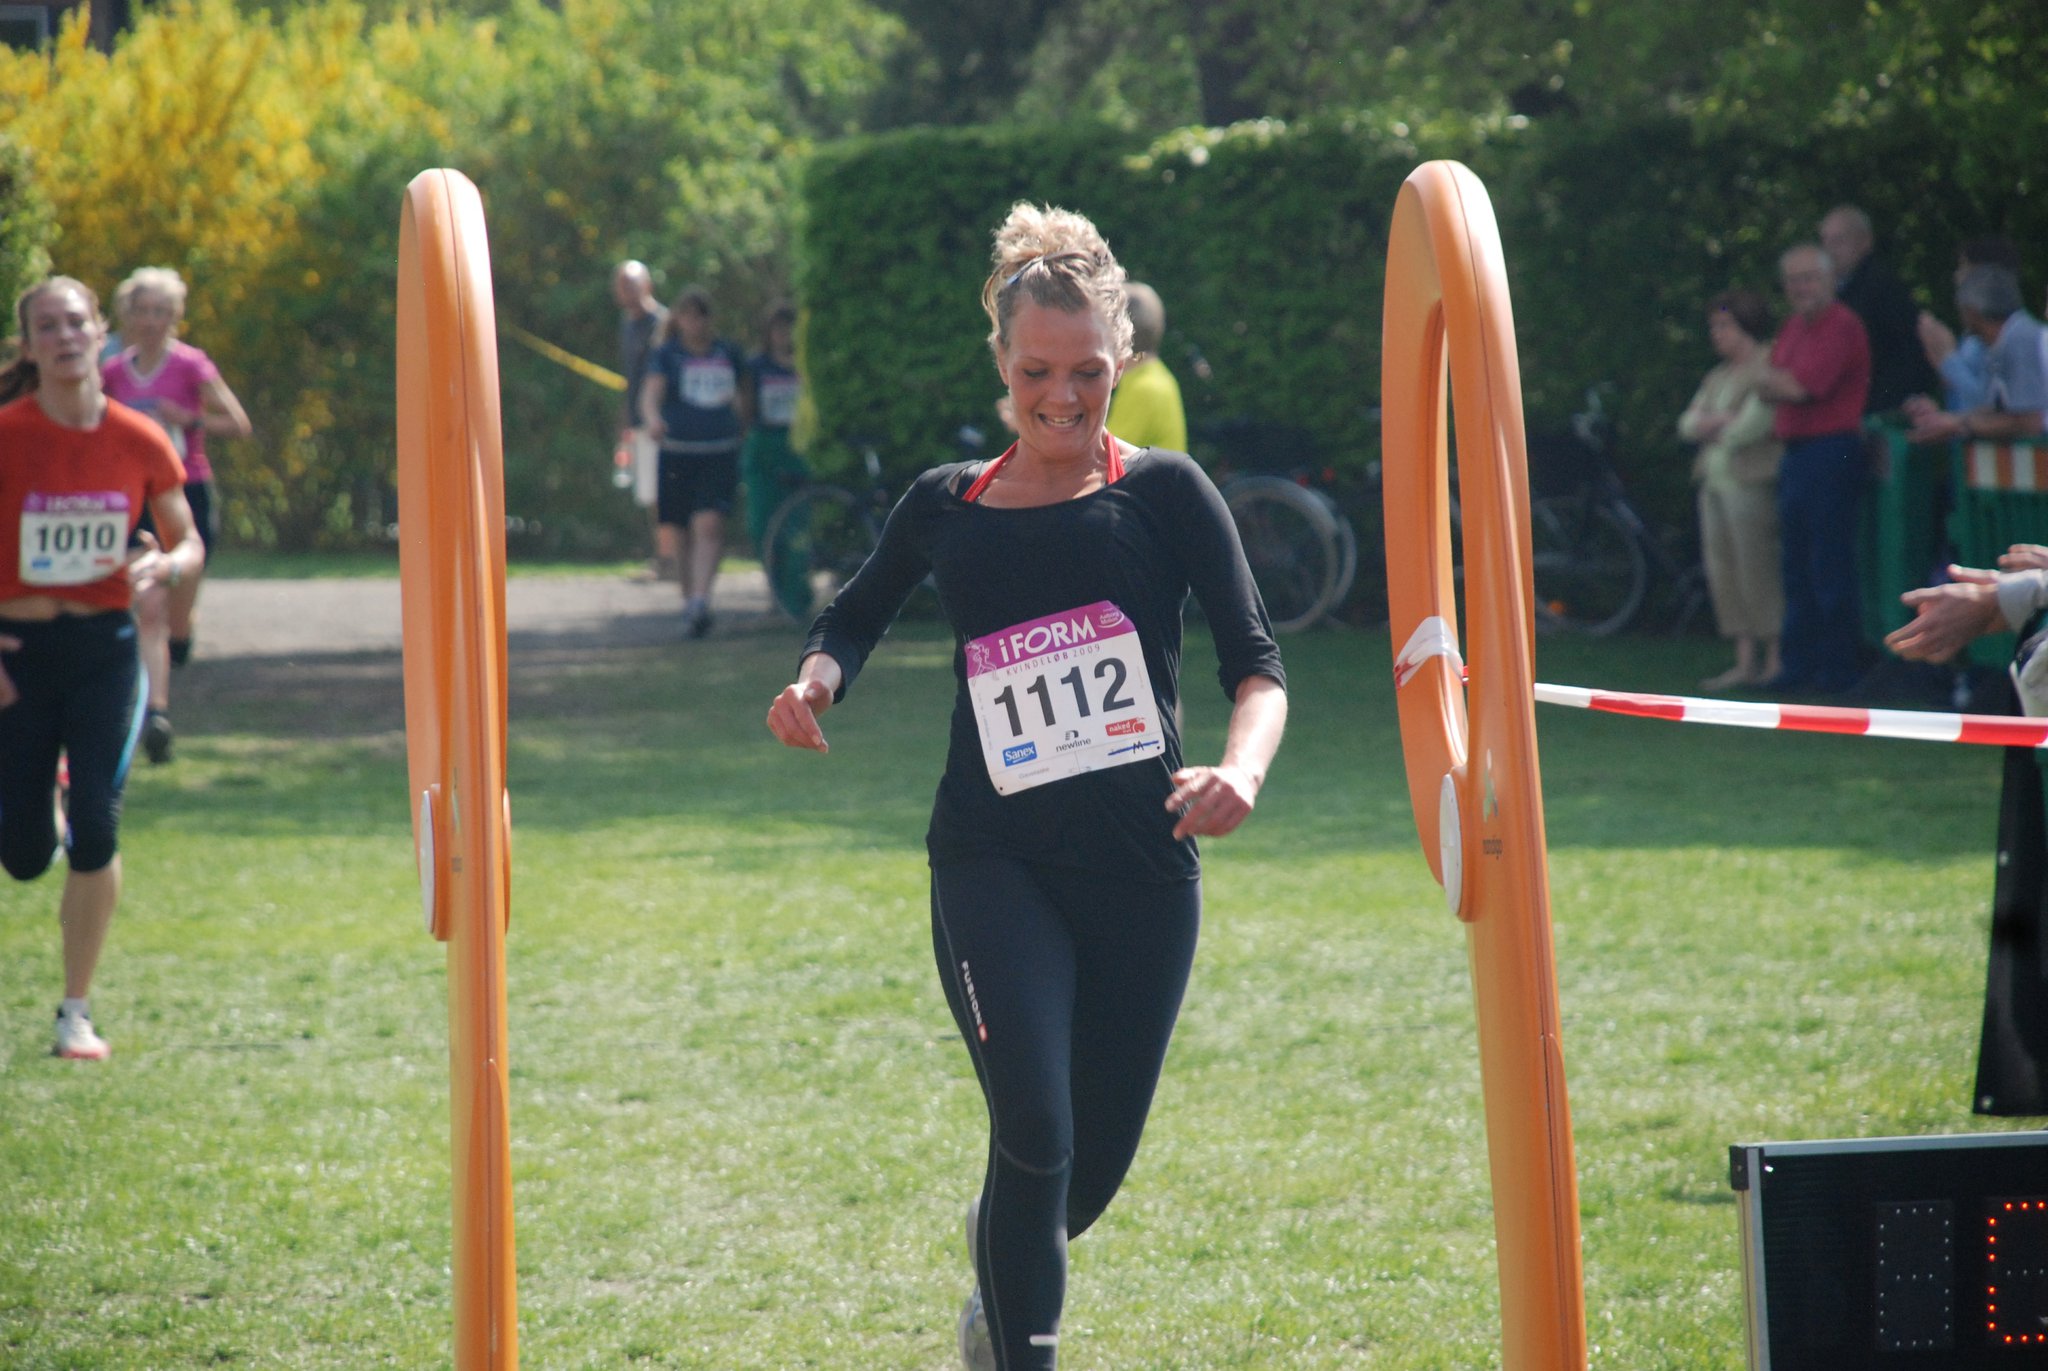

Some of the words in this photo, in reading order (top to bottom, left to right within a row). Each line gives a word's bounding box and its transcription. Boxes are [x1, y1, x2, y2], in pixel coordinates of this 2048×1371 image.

[37, 523, 115, 552] 1010
[1073, 643, 1101, 659] 2009
[993, 657, 1135, 737] 1112
[1005, 746, 1034, 761] Sanex
[1056, 738, 1091, 753] newline
